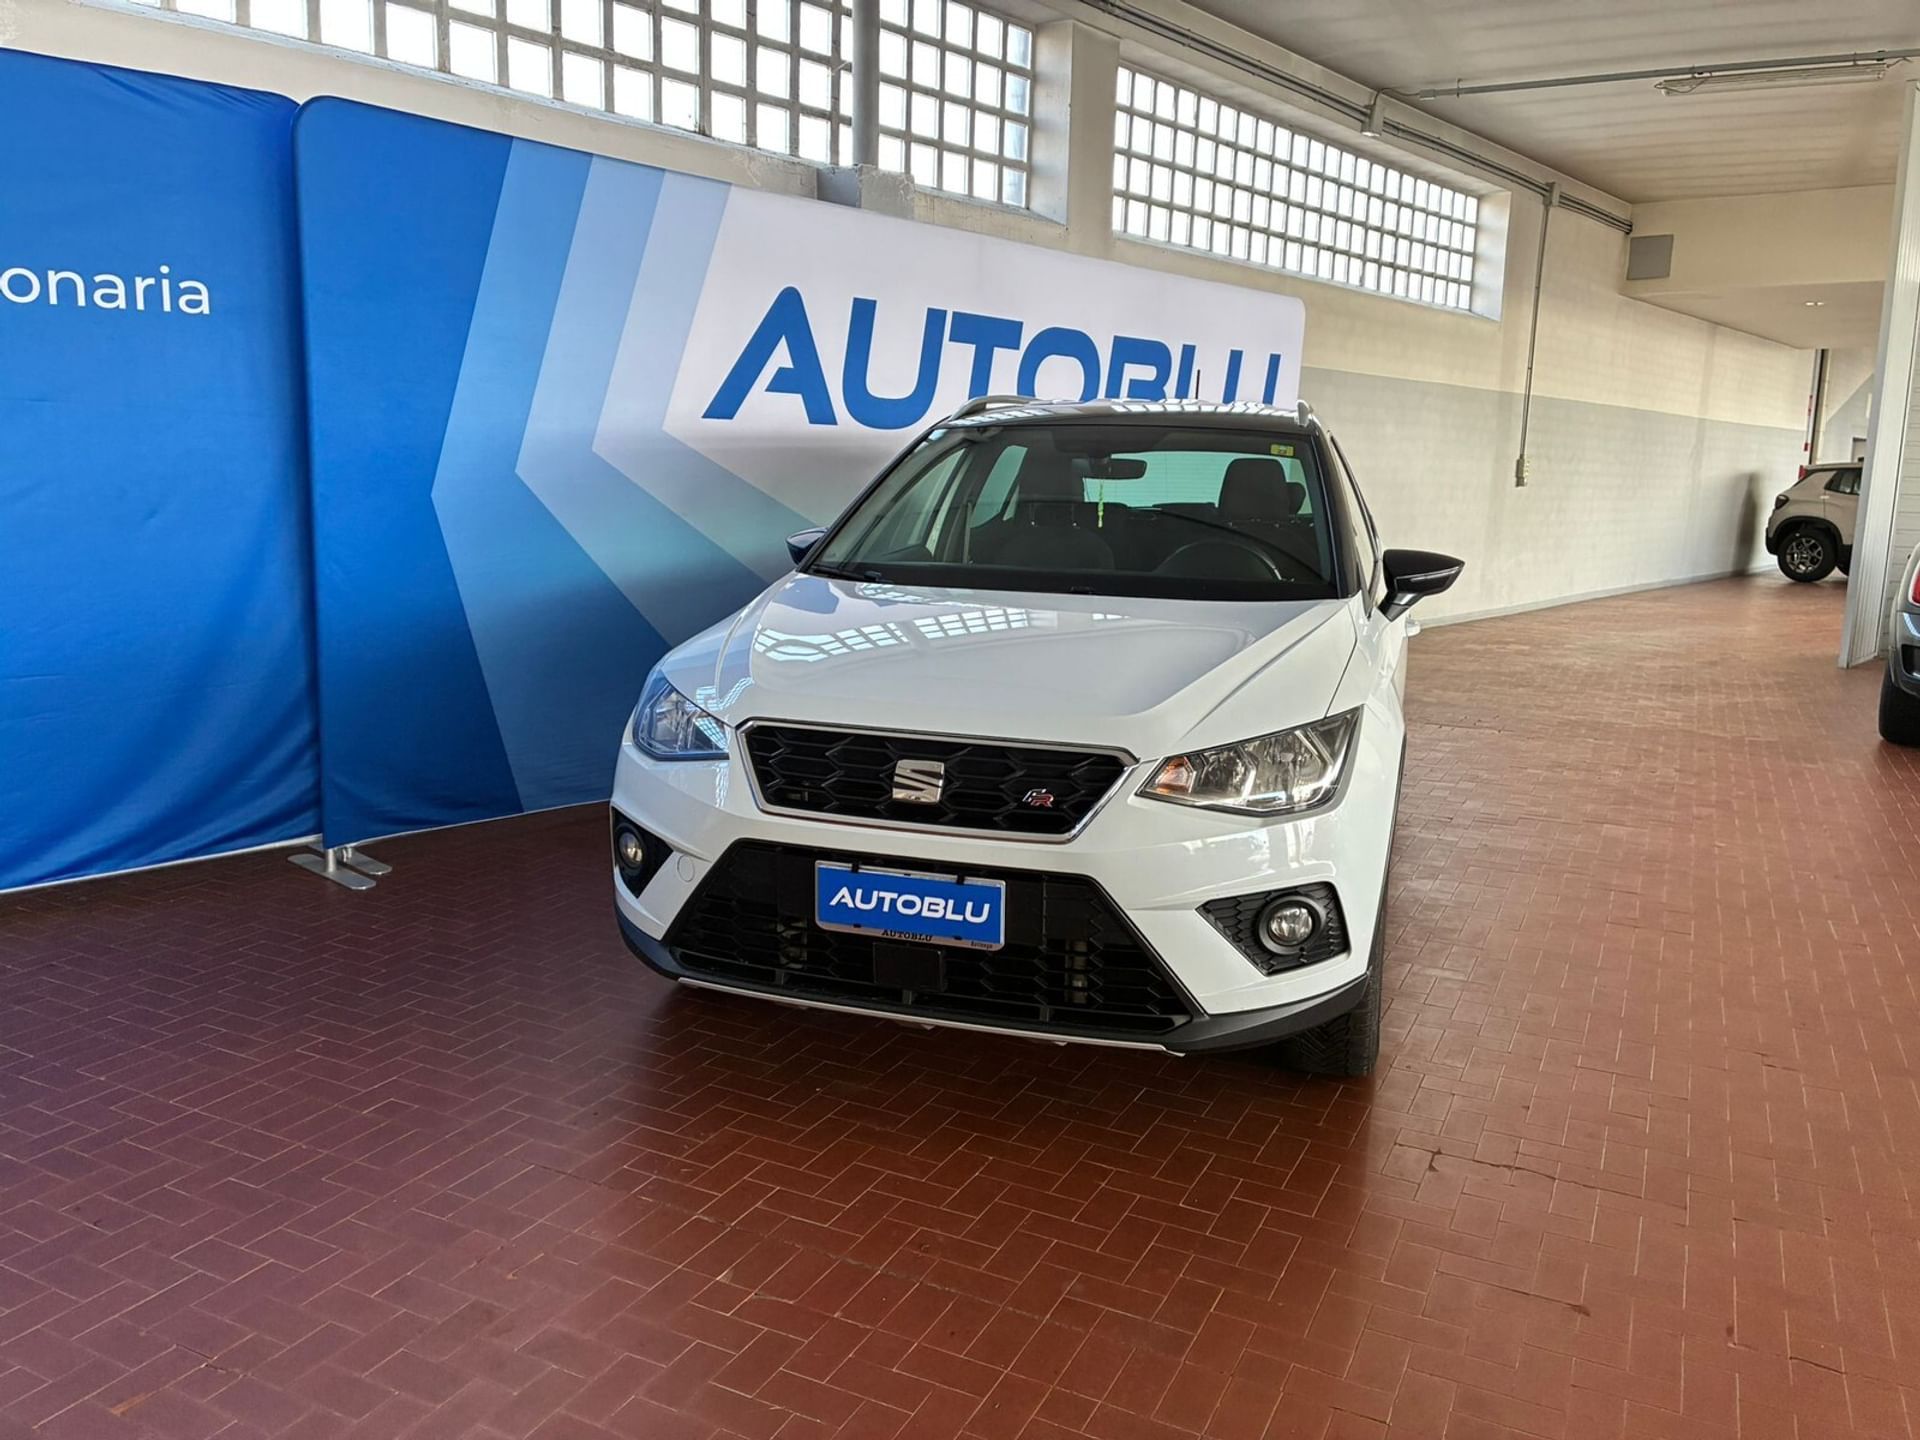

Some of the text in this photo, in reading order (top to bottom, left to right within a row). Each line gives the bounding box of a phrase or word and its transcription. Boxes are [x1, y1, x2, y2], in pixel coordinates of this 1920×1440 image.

[0, 265, 210, 315] onaria
[829, 886, 991, 924] AUTOBLU
[881, 929, 933, 942] AUTOBLU
